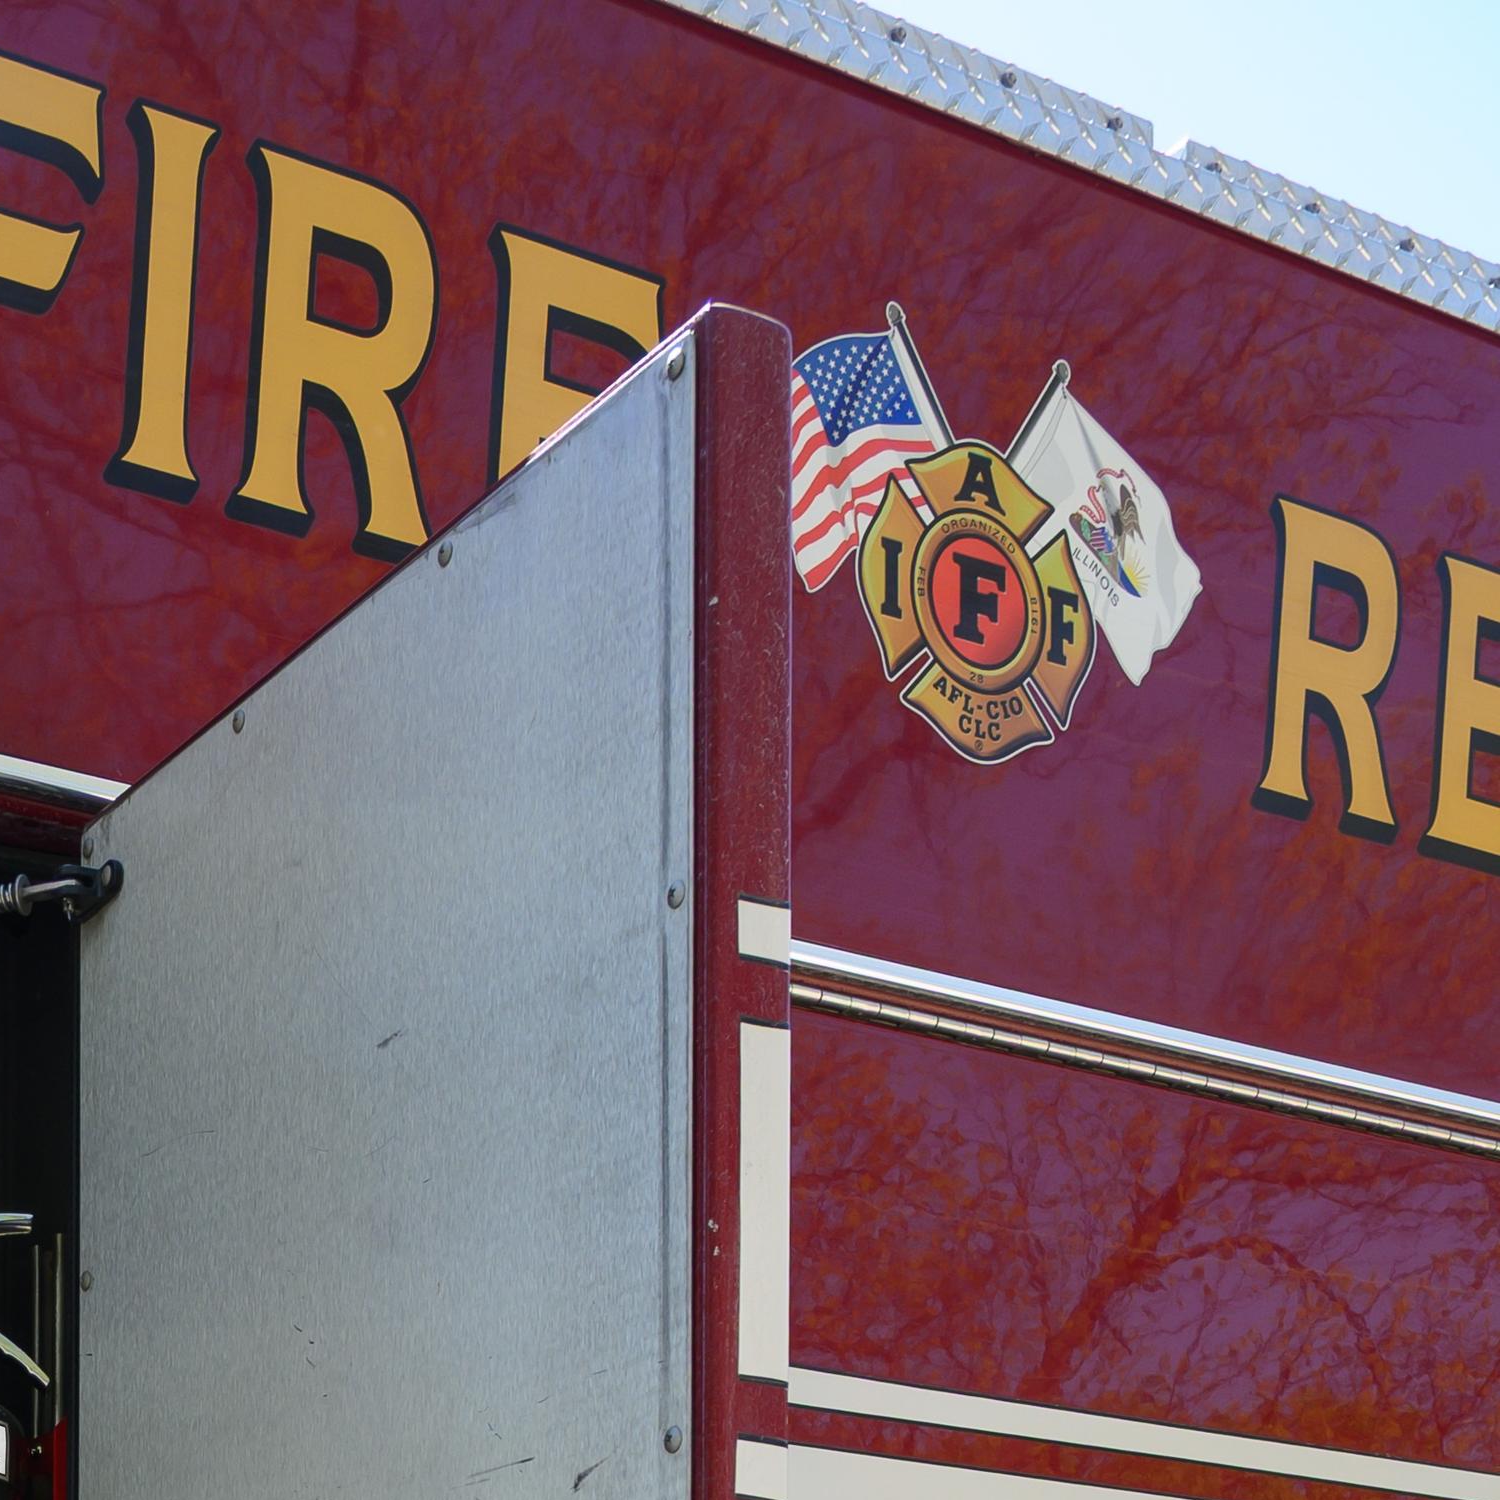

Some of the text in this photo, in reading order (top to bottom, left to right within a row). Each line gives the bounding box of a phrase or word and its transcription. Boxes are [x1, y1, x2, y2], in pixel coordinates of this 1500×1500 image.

[954, 452, 1007, 516] A
[941, 516, 1017, 556] ORGANIZED
[881, 537, 903, 620] I
[953, 551, 1007, 646] F
[1072, 547, 1120, 607] ILLINOIS
[1047, 585, 1080, 666] F
[933, 676, 1024, 719] AFL-CIO
[969, 671, 985, 684] 28
[958, 714, 1001, 741] CLC
